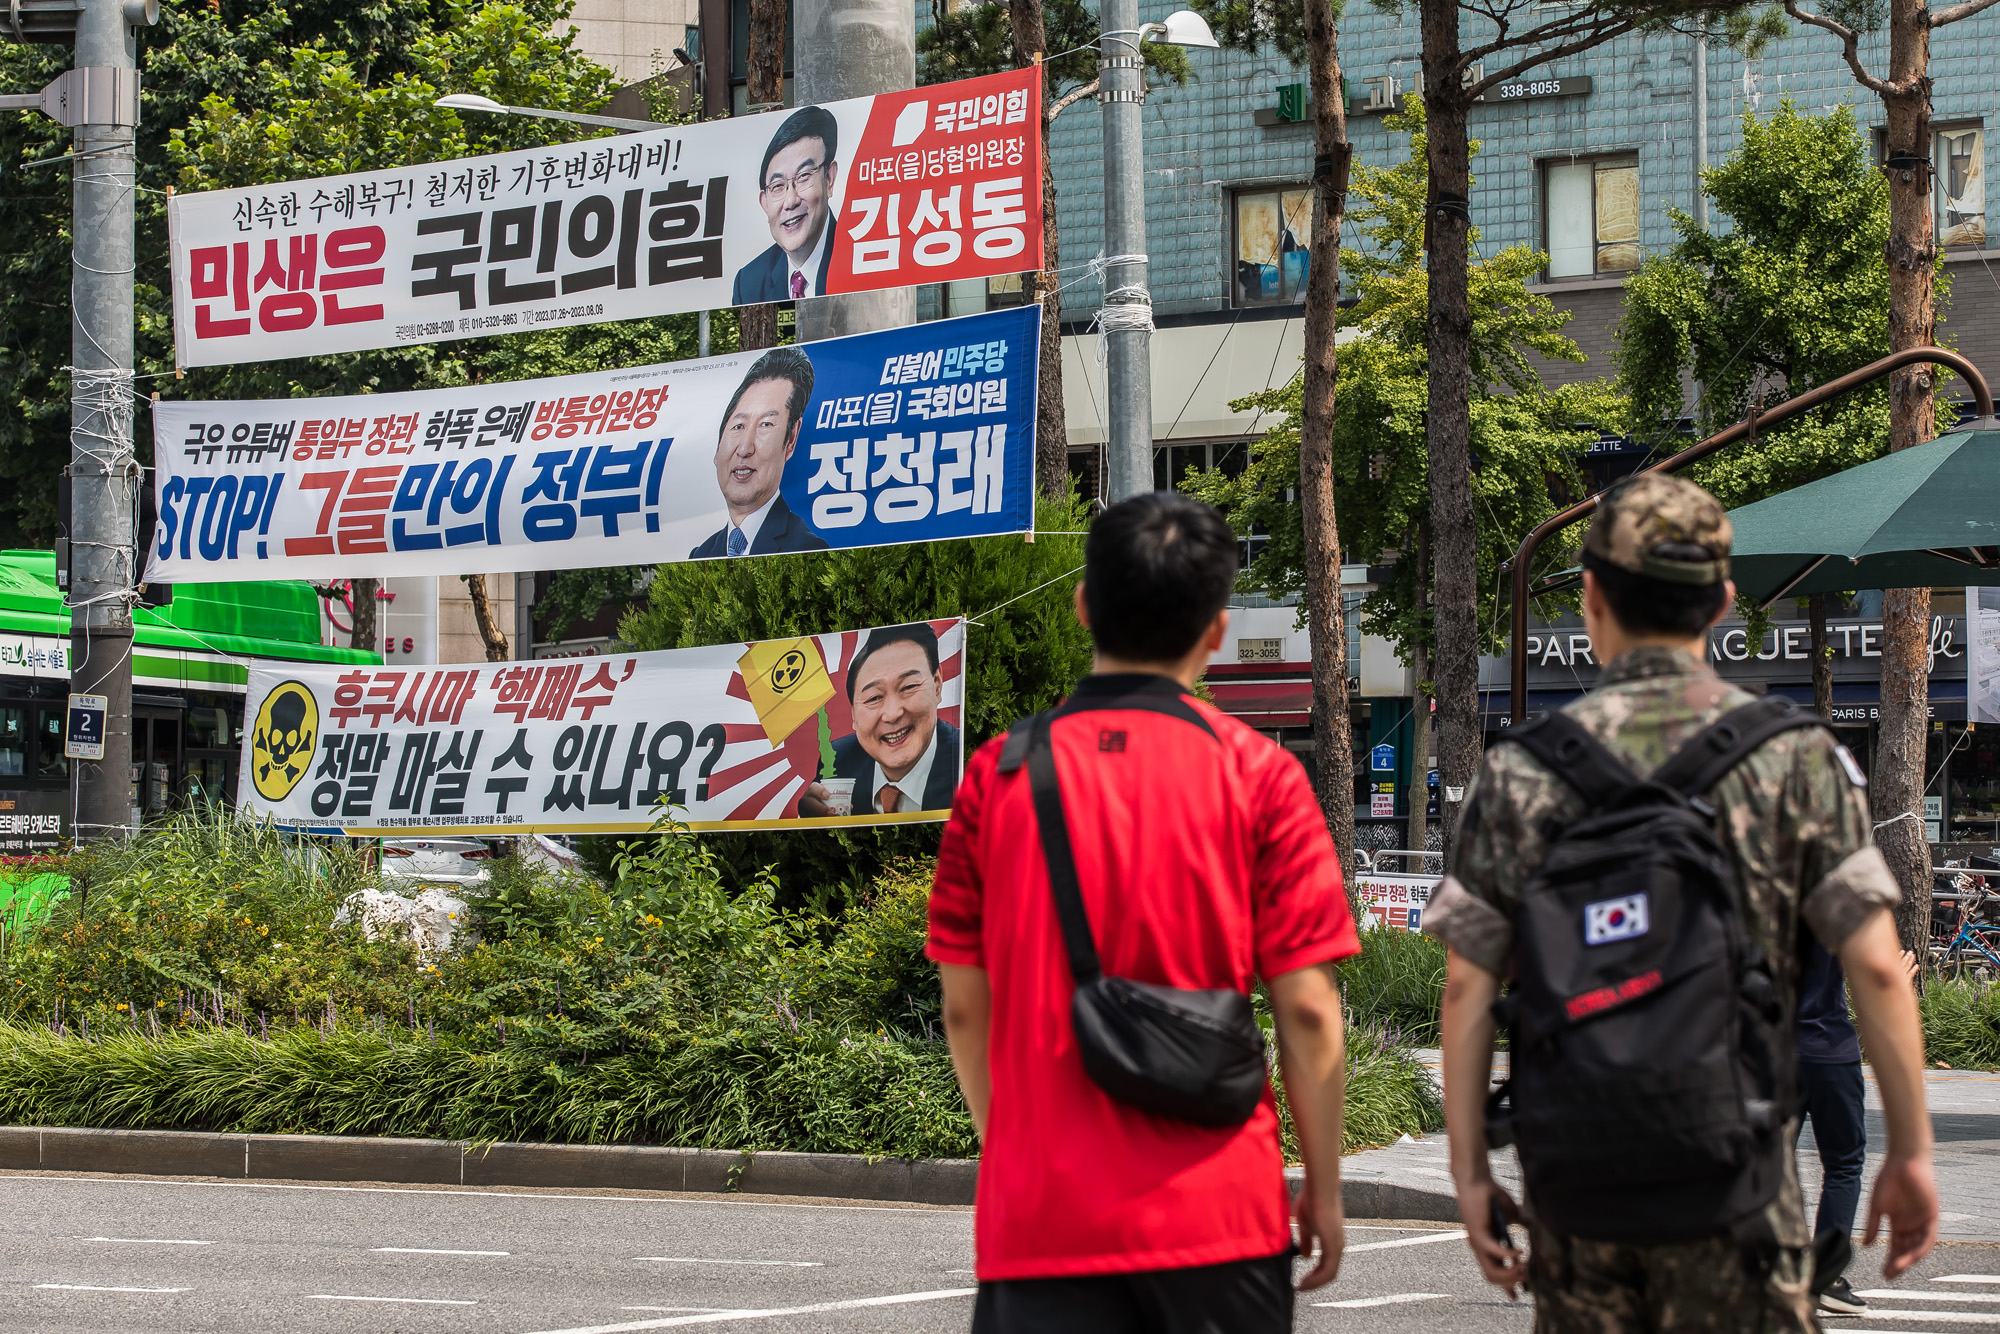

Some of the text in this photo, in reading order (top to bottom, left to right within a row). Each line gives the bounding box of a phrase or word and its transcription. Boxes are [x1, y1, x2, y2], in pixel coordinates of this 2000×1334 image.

[934, 88, 1028, 134] 국민의힘
[1501, 80, 1560, 99] 338-8055
[859, 136, 1026, 185] 마포(을)당협위원장
[232, 138, 682, 231] 신속한 수해복구! 철저한 기후변화대비!
[848, 176, 1026, 275] 김성동
[189, 176, 729, 339] 민생은 국민의힘
[395, 323, 416, 341] 국민의힘
[417, 320, 454, 336] 02-6288-0200
[458, 316, 471, 334] 제작
[471, 313, 518, 330] 010-5320-9863
[522, 309, 534, 326] 기간
[880, 340, 1008, 386] 더불어민주당
[184, 385, 669, 465] 극우 유튜버 통일부 장관, 학폭 은폐 방통위원장
[815, 378, 1007, 430] 마포(을) 국회의원
[158, 437, 674, 561] STOP! 그들만의 정부!
[807, 424, 1007, 529] 정청래
[1240, 649, 1279, 658] 323-3055
[1527, 634, 1603, 666] PAR
[329, 669, 480, 728] 후쿠시마
[1831, 708, 1866, 719] PARIS
[81, 713, 91, 731] 2
[310, 720, 727, 817] 정말 마실 수 있나요?
[1380, 757, 1388, 768] 4
[495, 815, 502, 824] 수
[502, 814, 525, 824] 있습니다.
[1388, 884, 1409, 904] 장관,
[1410, 885, 1429, 905] 학폭
